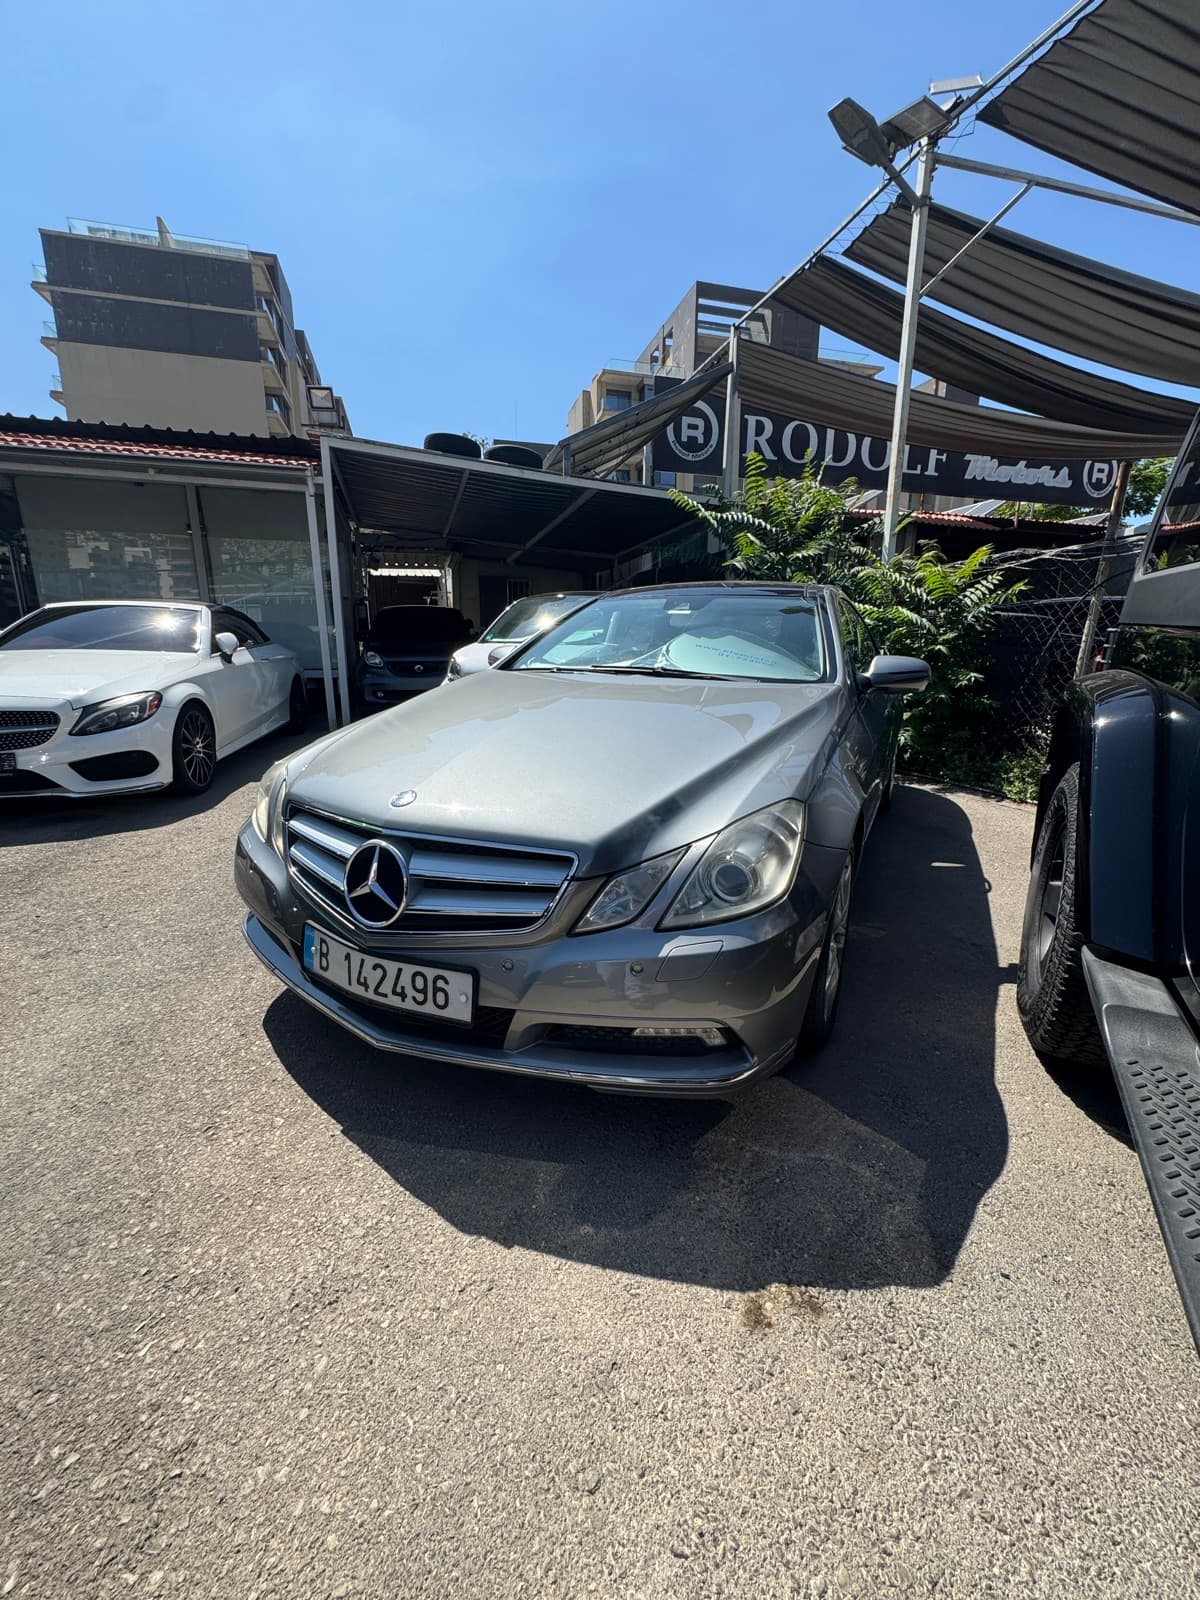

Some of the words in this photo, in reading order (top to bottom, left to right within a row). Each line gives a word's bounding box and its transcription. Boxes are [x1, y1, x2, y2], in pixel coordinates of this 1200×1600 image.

[681, 415, 705, 444] R
[963, 453, 1073, 488] Motors
[1091, 462, 1110, 485] R
[319, 937, 330, 972] B
[344, 952, 450, 1010] 142496
